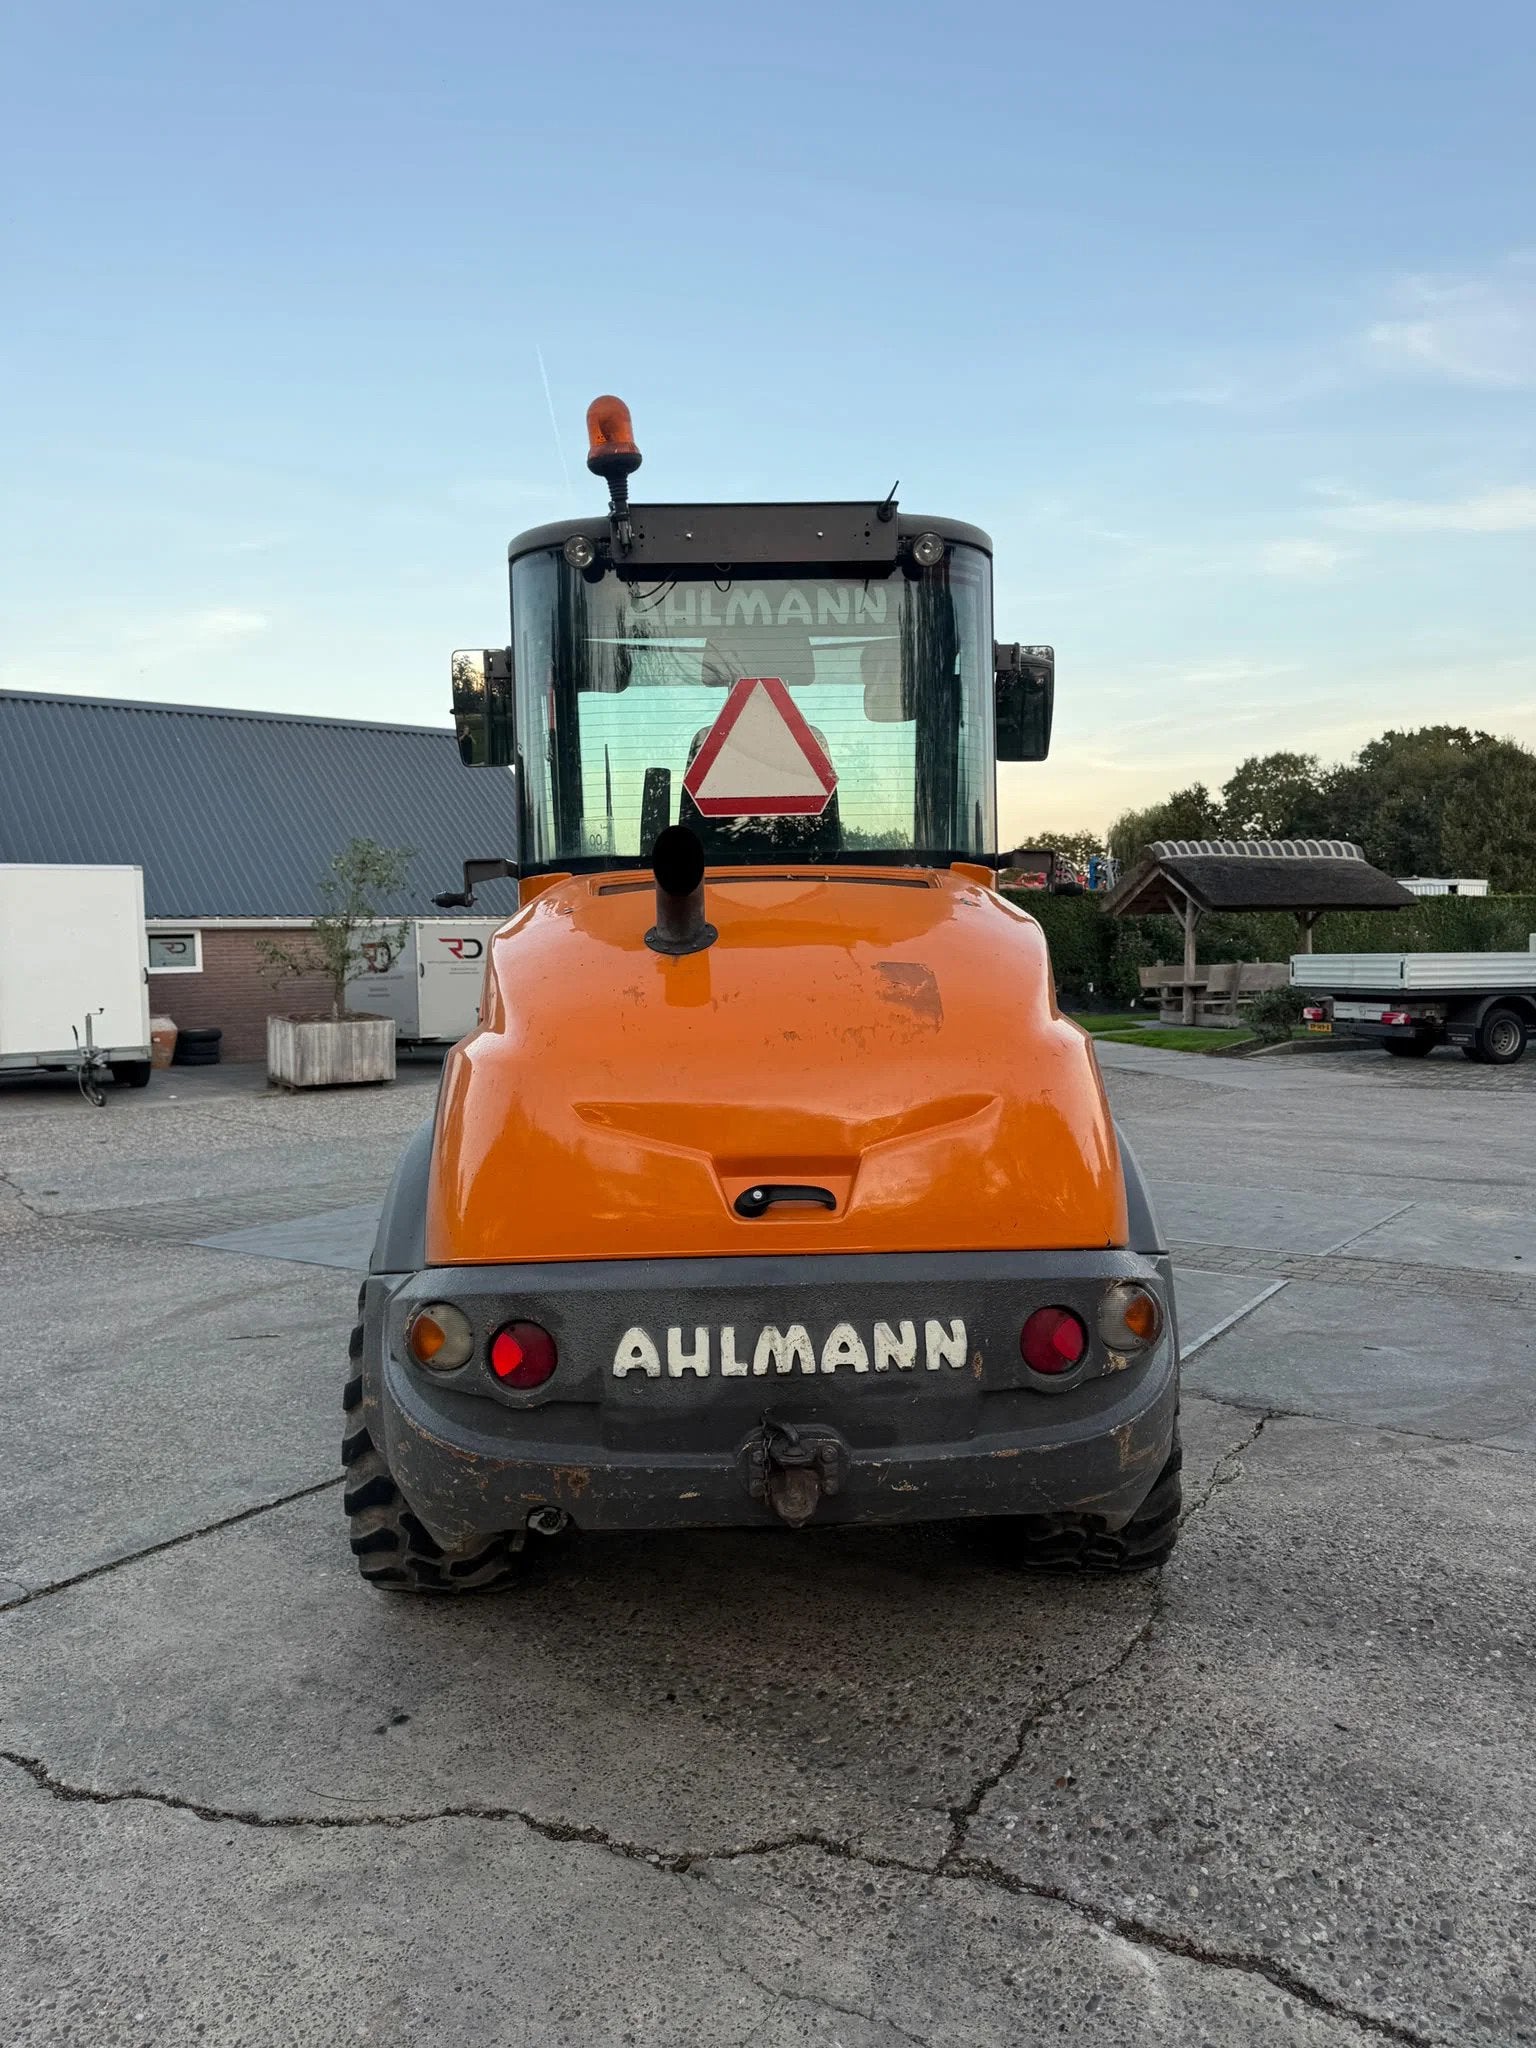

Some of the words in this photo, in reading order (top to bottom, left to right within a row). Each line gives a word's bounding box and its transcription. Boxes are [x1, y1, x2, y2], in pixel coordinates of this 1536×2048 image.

[625, 587, 887, 626] AHLMANN
[438, 938, 483, 959] RD
[612, 1319, 968, 1377] AHLMANN
